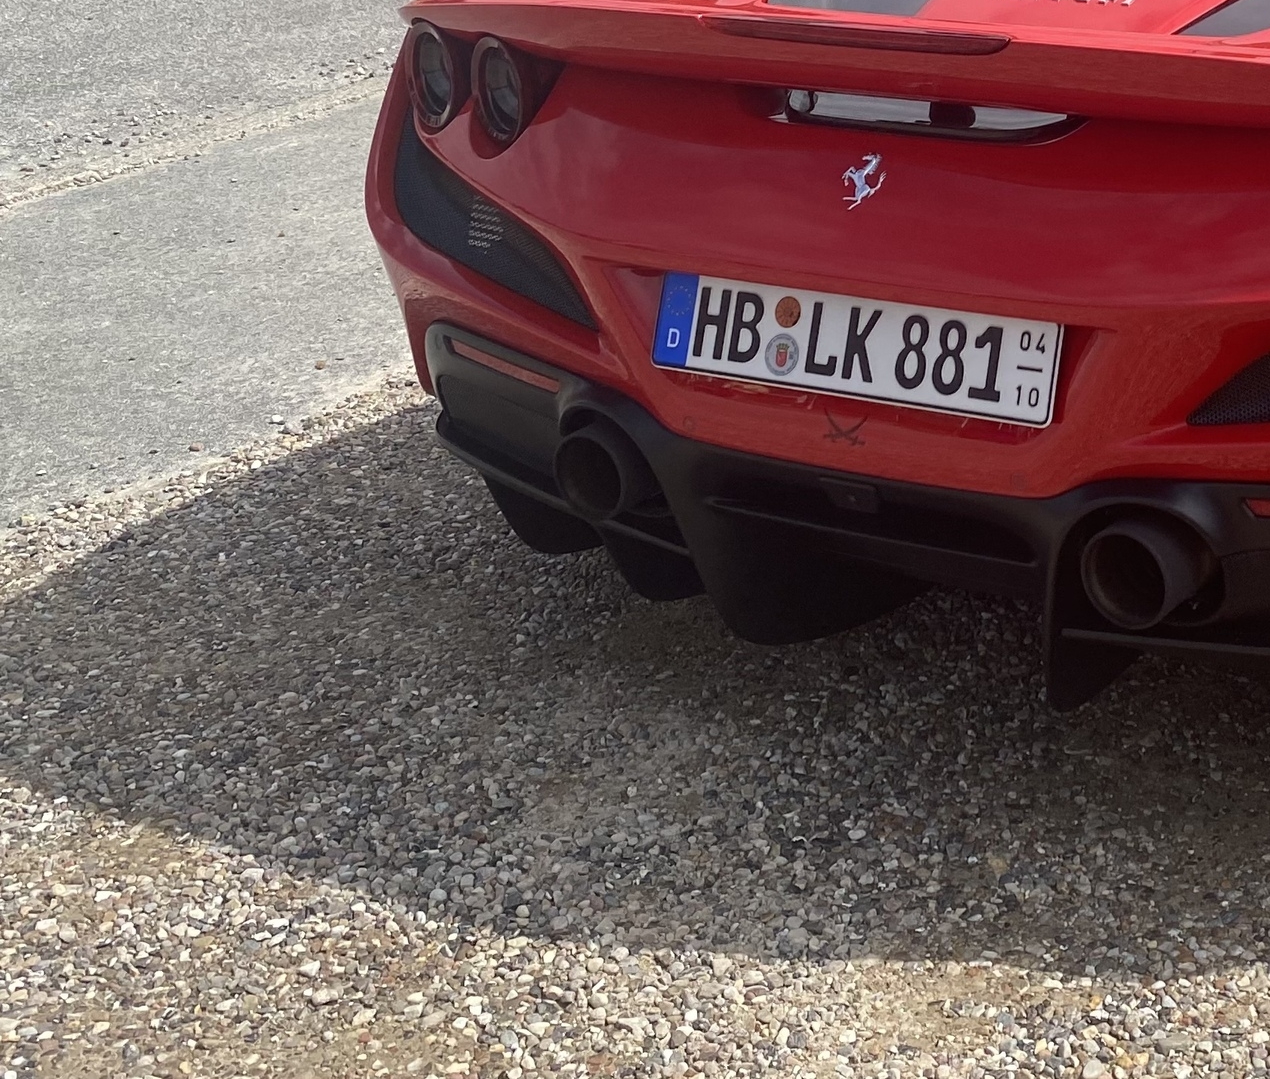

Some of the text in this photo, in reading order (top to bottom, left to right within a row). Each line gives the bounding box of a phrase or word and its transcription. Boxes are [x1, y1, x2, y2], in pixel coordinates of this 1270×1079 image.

[667, 327, 680, 349] D
[692, 286, 764, 364] HB
[804, 301, 883, 384] LK
[895, 314, 1004, 404] 881
[1020, 331, 1045, 354] 04
[1016, 384, 1039, 408] 10
